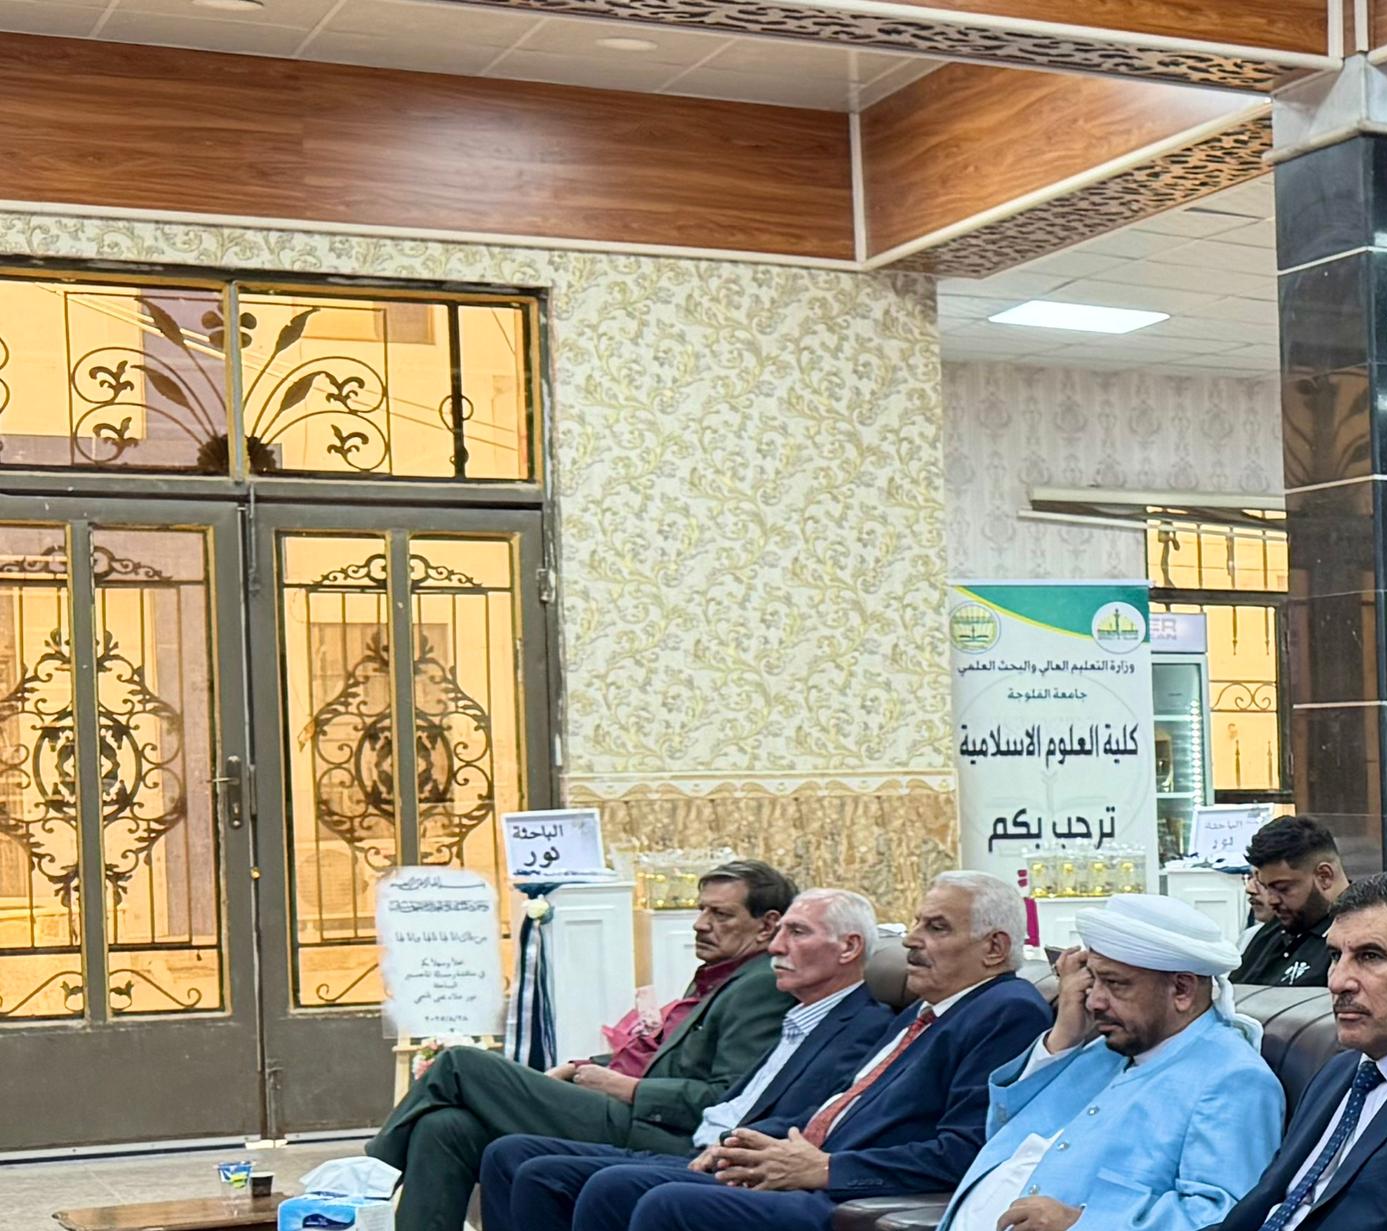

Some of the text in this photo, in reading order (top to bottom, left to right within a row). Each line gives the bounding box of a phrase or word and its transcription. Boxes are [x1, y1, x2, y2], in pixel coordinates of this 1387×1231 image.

[957, 660, 1135, 677] وزارة التعليم العالي والبحث العلمي
[1008, 687, 1087, 702] جامعة الفلوجة
[960, 723, 1138, 768] كلية العلوم الاسلامية
[512, 824, 563, 841] الباحثة
[988, 806, 1115, 853] ترحب بكم
